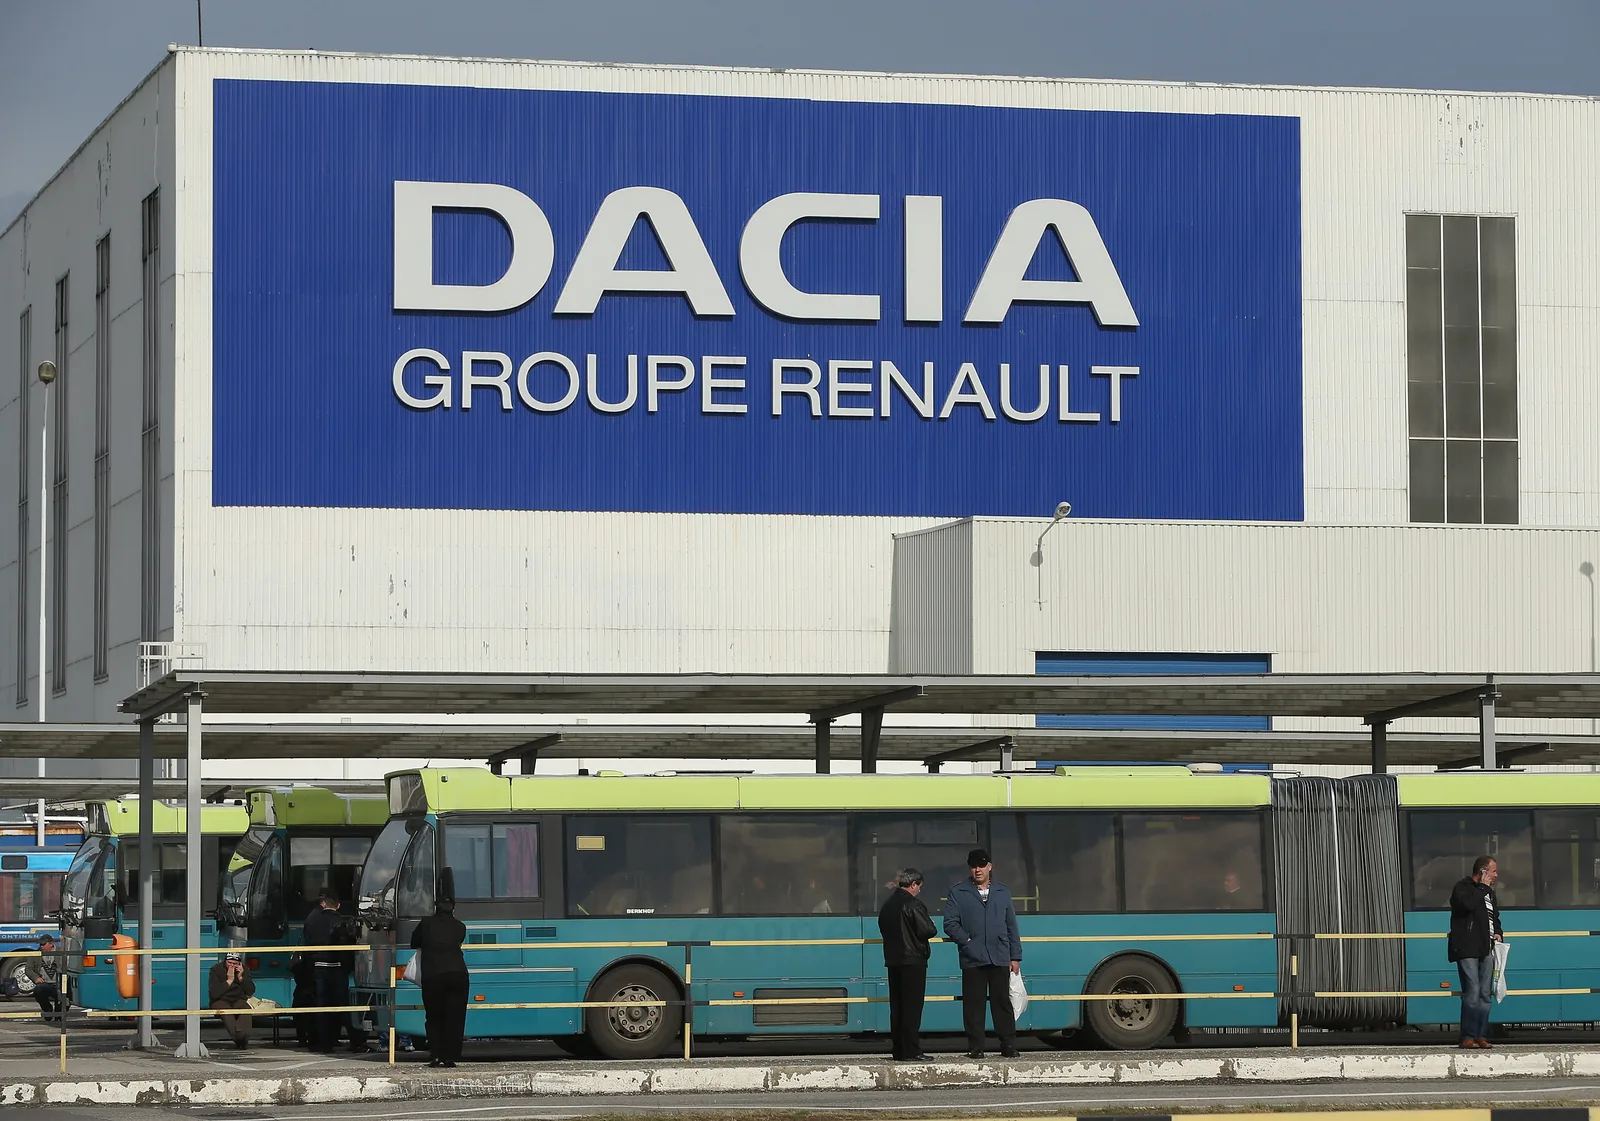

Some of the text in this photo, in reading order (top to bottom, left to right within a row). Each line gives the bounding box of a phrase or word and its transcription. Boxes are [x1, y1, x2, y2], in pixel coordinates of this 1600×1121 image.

[393, 180, 1140, 327] DACIA
[392, 347, 1140, 423] GROUPE RENAULT
